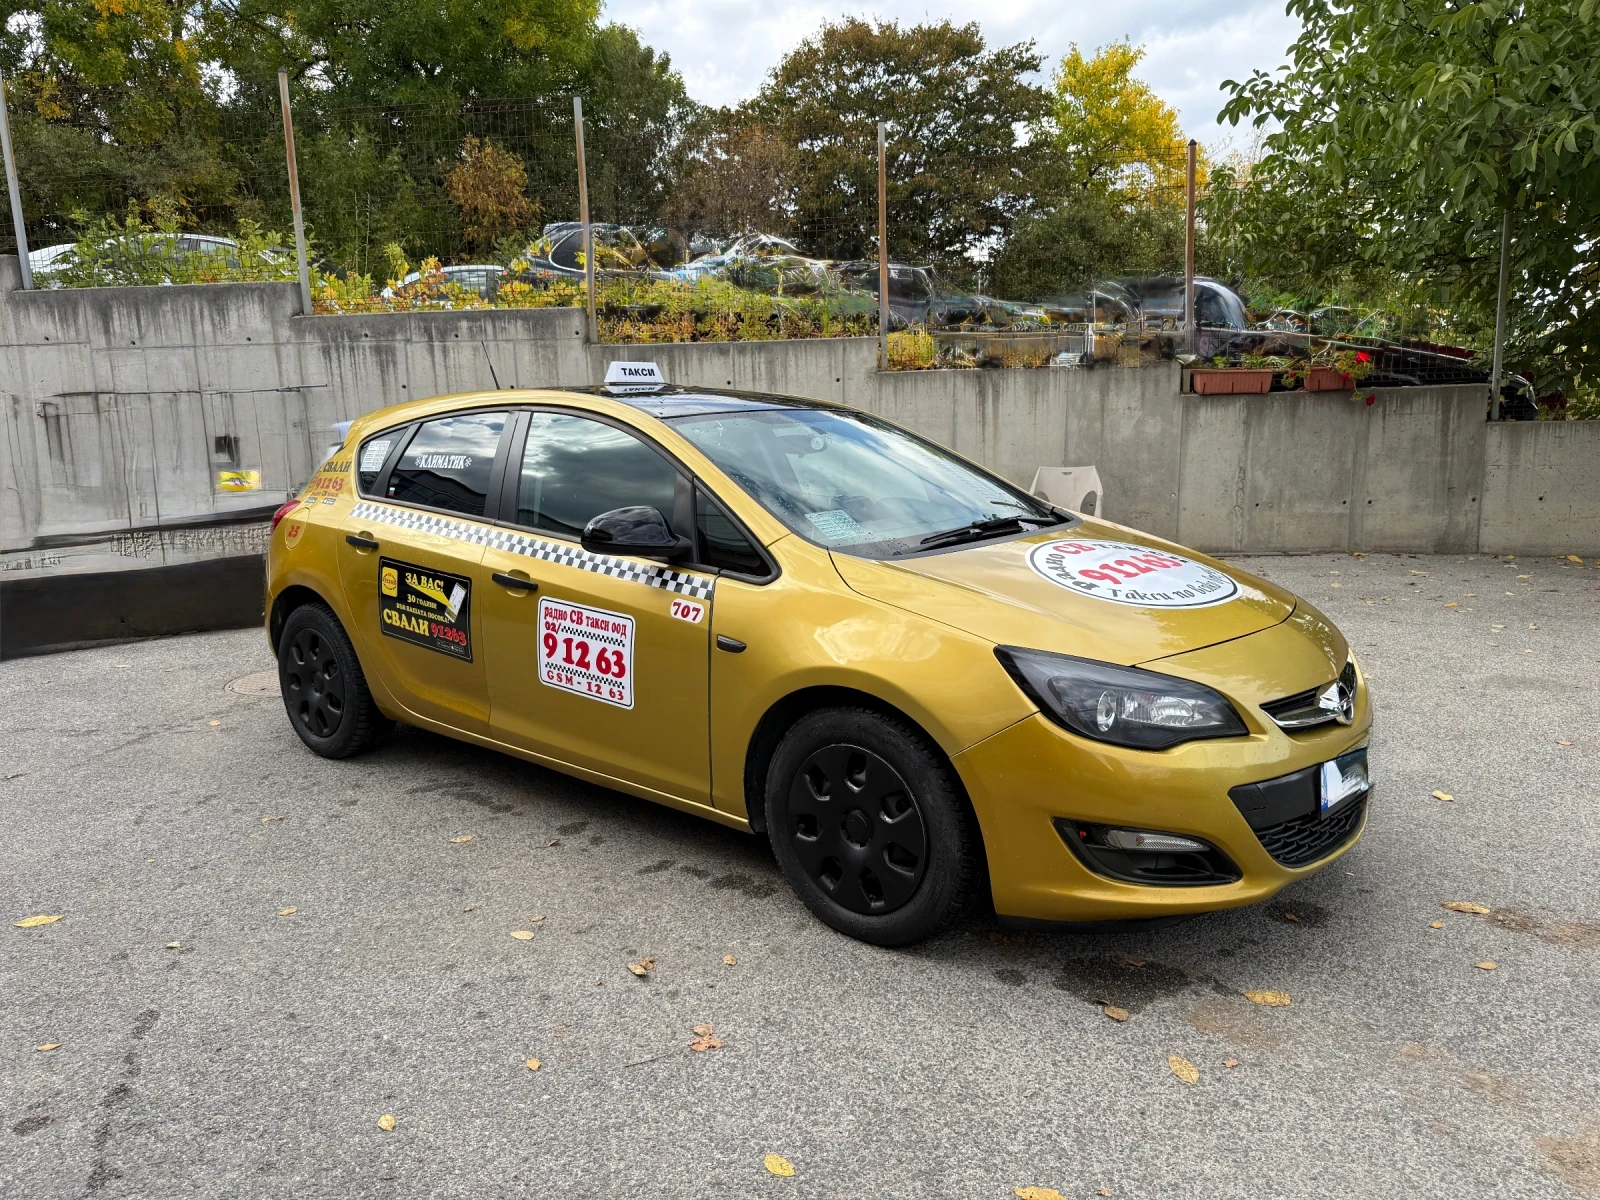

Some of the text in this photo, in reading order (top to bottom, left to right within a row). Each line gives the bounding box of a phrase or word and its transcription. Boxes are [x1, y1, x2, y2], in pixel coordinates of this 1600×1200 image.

[621, 367, 655, 376] ТАКСИ
[322, 461, 352, 473] СВАЛИ
[419, 454, 467, 469] КЛИМАТИК
[288, 525, 300, 538] 25
[1052, 543, 1096, 555] СВ
[405, 572, 419, 586] ЗА
[420, 575, 444, 592] ВАС!
[407, 594, 416, 603] 30
[1172, 589, 1195, 599] по
[672, 601, 702, 622] 707
[383, 608, 467, 646] СВАЛИ 91263
[544, 606, 627, 640] радио СВ такси оод
